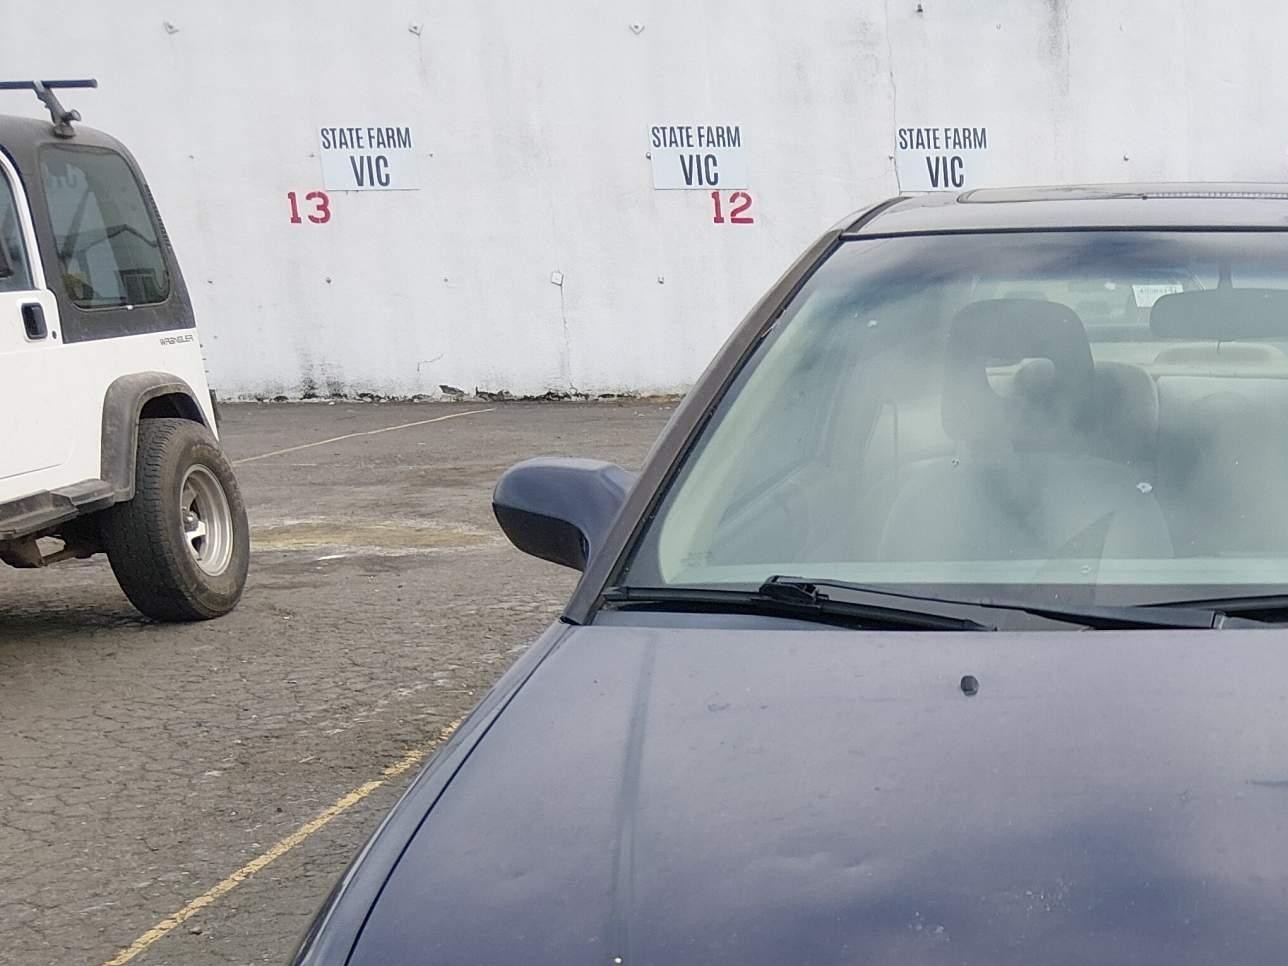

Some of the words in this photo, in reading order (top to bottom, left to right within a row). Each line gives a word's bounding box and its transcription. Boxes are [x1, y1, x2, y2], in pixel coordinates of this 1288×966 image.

[321, 127, 364, 149] STATE
[367, 127, 412, 149] FARM
[651, 126, 694, 148] STATE
[697, 125, 741, 148] FARM
[898, 128, 941, 150] STATE
[944, 127, 987, 149] FARM
[350, 155, 391, 187] VIC
[680, 153, 719, 186] VIC
[926, 156, 965, 188] VIC
[287, 191, 331, 224] 13
[711, 191, 754, 224] 12
